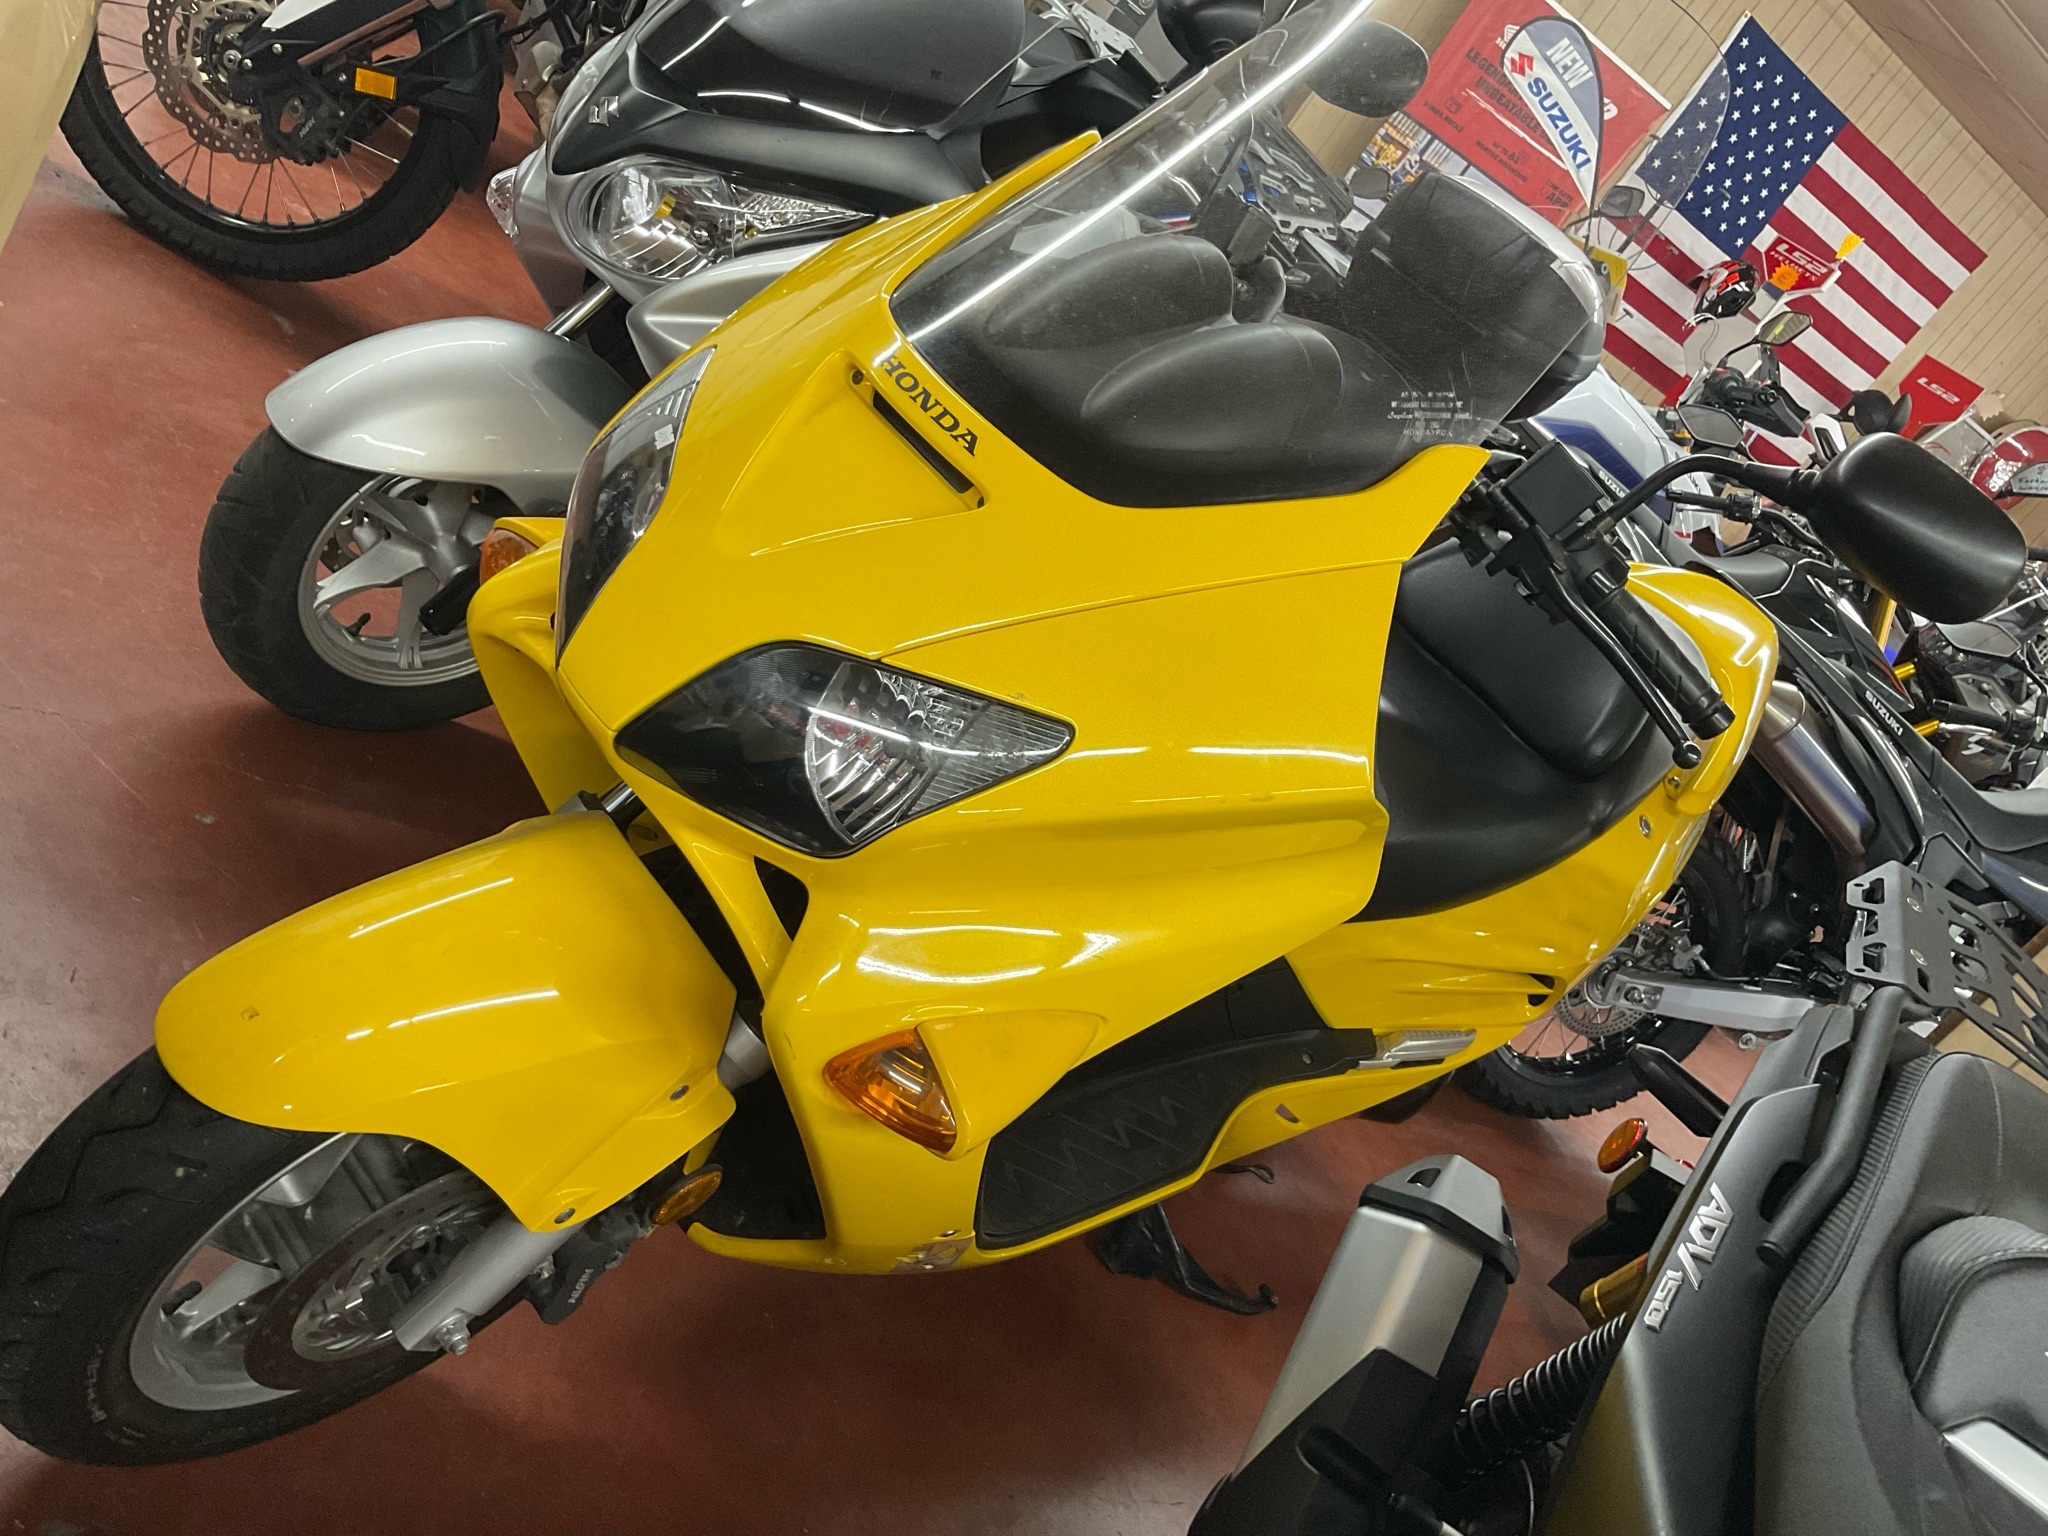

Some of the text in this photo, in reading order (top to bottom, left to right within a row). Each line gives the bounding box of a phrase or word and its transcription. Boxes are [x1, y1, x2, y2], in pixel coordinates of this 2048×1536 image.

[1546, 37, 1593, 89] NEW
[1475, 76, 1539, 133] UNBEATABLE
[1527, 77, 1592, 170] SUZUKI
[1769, 251, 1818, 281] HELMETS
[1775, 243, 1828, 276] LS2
[880, 353, 979, 457] HONDA
[1916, 376, 1960, 405] LS2
[1599, 470, 1626, 499] SUZU
[1865, 690, 1904, 736] SUZUKI
[1677, 1182, 1734, 1291] ADV
[1643, 1269, 1684, 1332] 150
